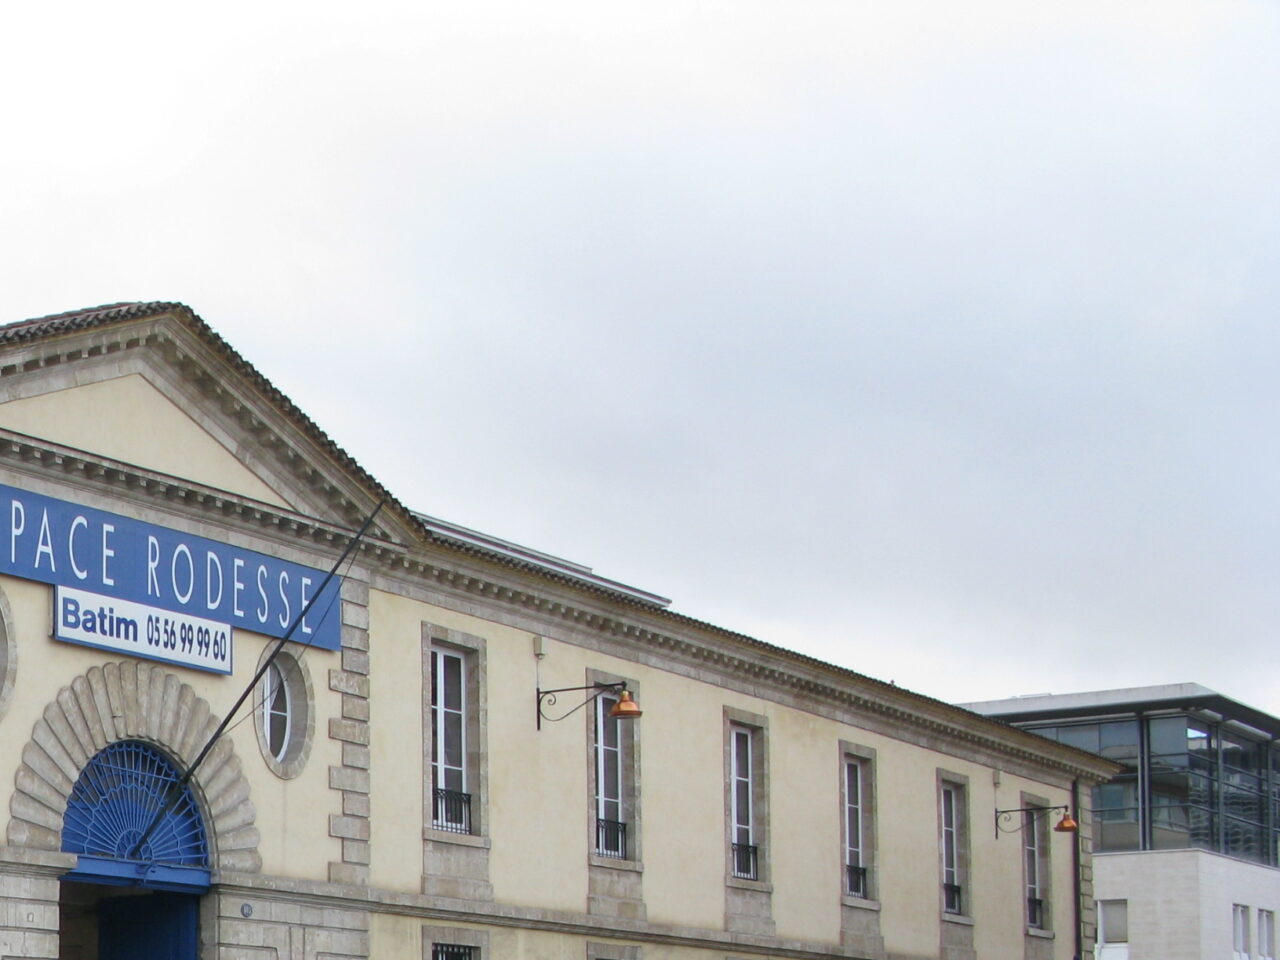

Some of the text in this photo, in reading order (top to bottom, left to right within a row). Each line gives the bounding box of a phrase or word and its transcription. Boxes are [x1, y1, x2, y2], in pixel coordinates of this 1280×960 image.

[147, 535, 312, 634] RODESSE
[62, 597, 227, 662] Batim 05 56 99 99 60
